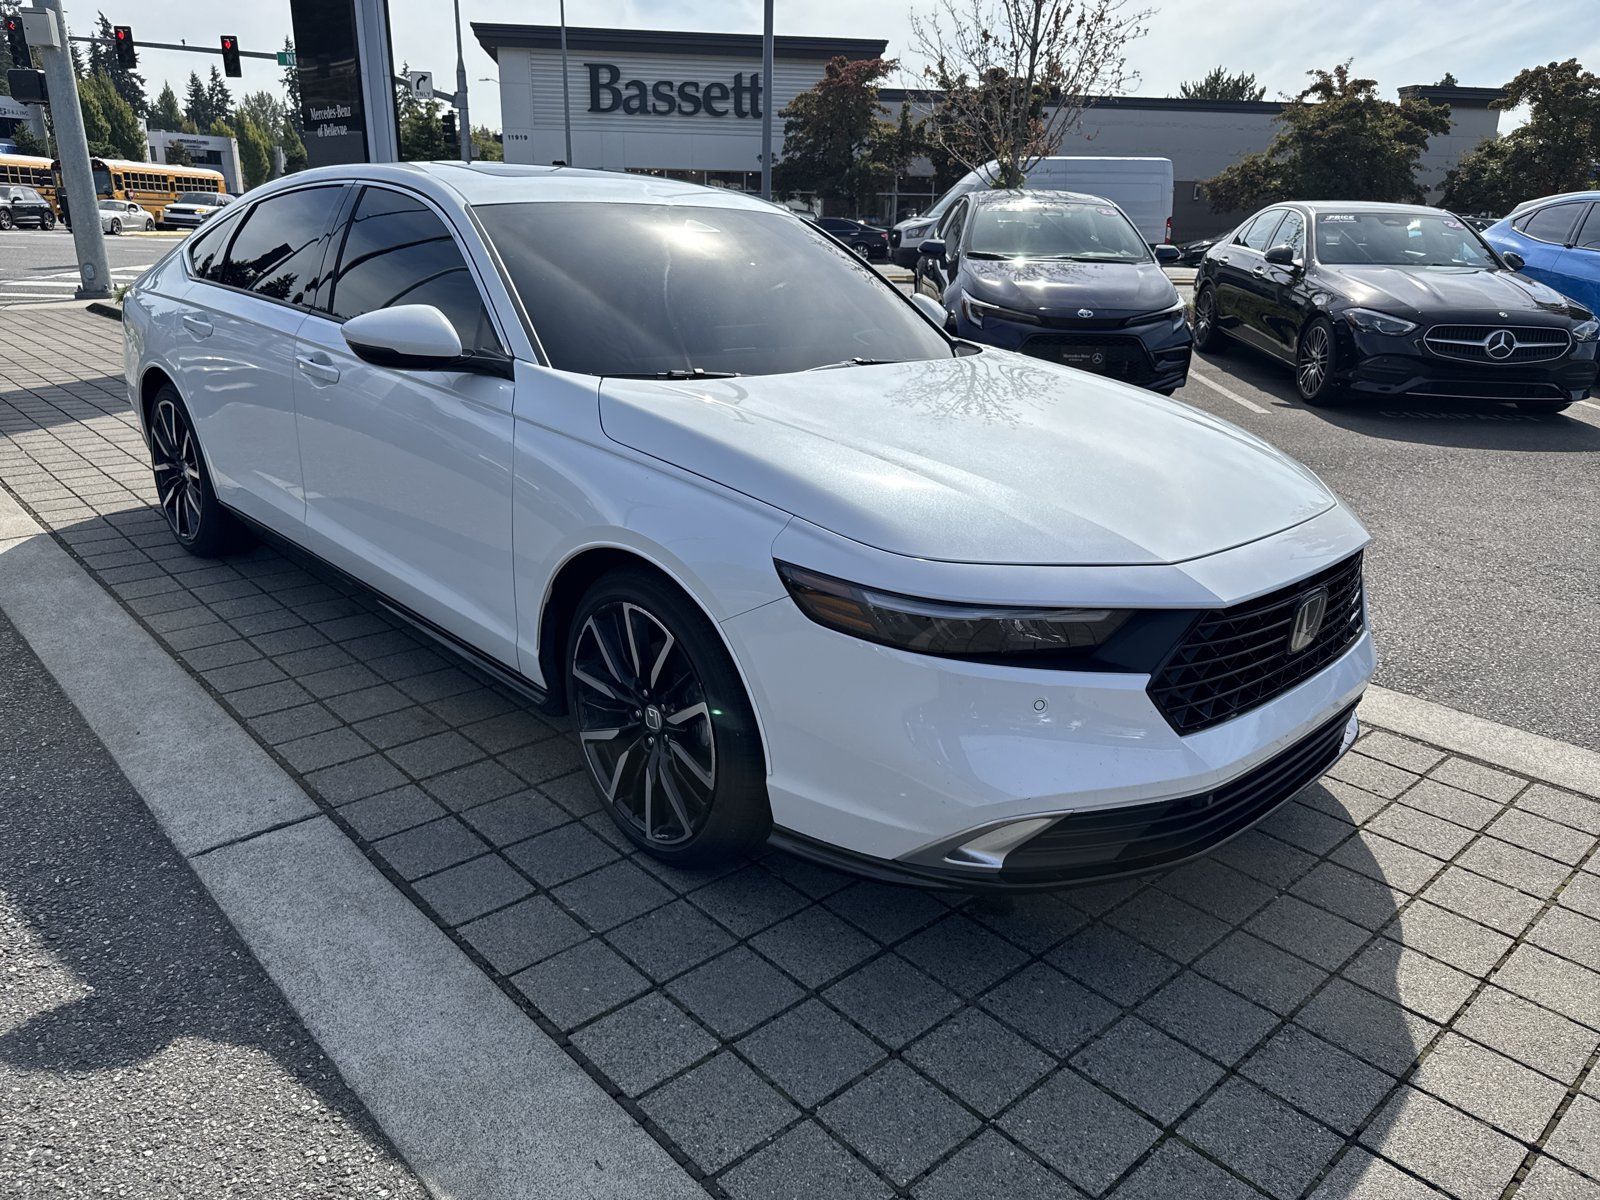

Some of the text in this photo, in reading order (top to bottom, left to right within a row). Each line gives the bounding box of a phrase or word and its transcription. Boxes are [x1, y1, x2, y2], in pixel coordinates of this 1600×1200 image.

[583, 62, 763, 119] Bassett
[310, 104, 351, 121] Mercedes-Benz
[317, 123, 348, 138] of Bellevue
